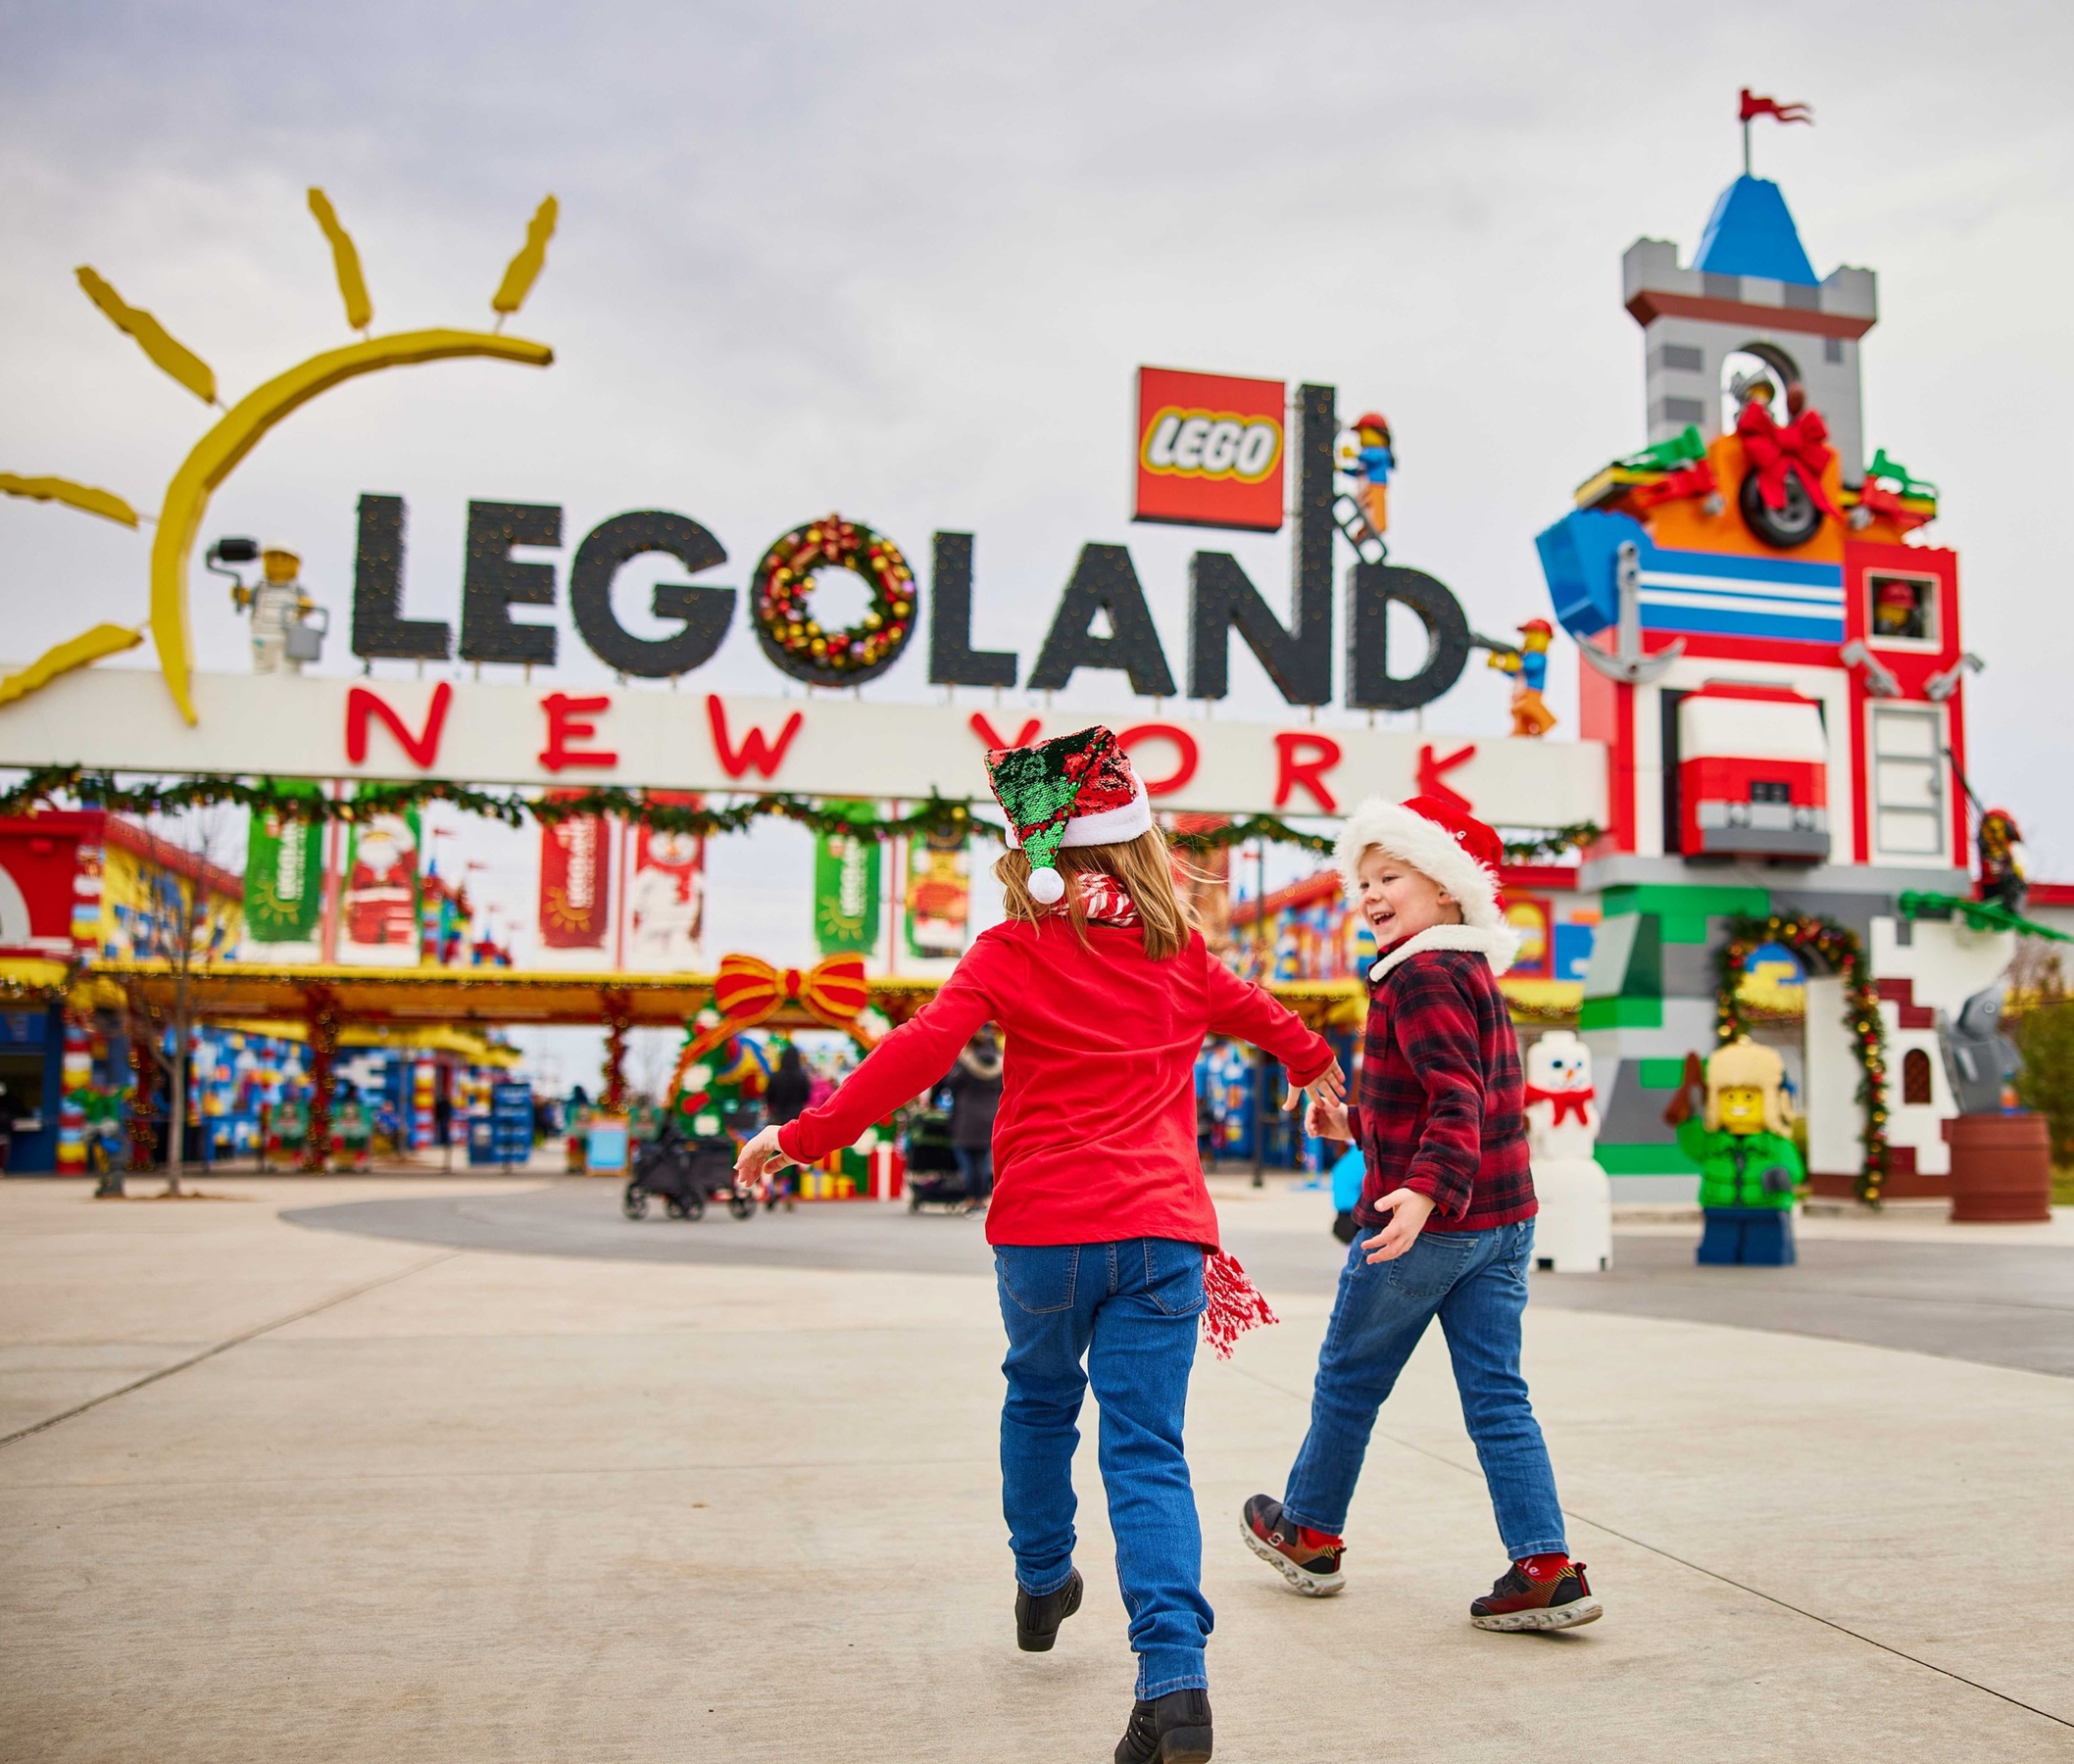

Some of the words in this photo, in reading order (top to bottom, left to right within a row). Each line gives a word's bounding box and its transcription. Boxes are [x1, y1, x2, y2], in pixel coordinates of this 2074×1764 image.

[1148, 414, 1276, 476] LEGO
[352, 381, 1471, 711] LEGOLAND
[345, 682, 805, 779] NEW
